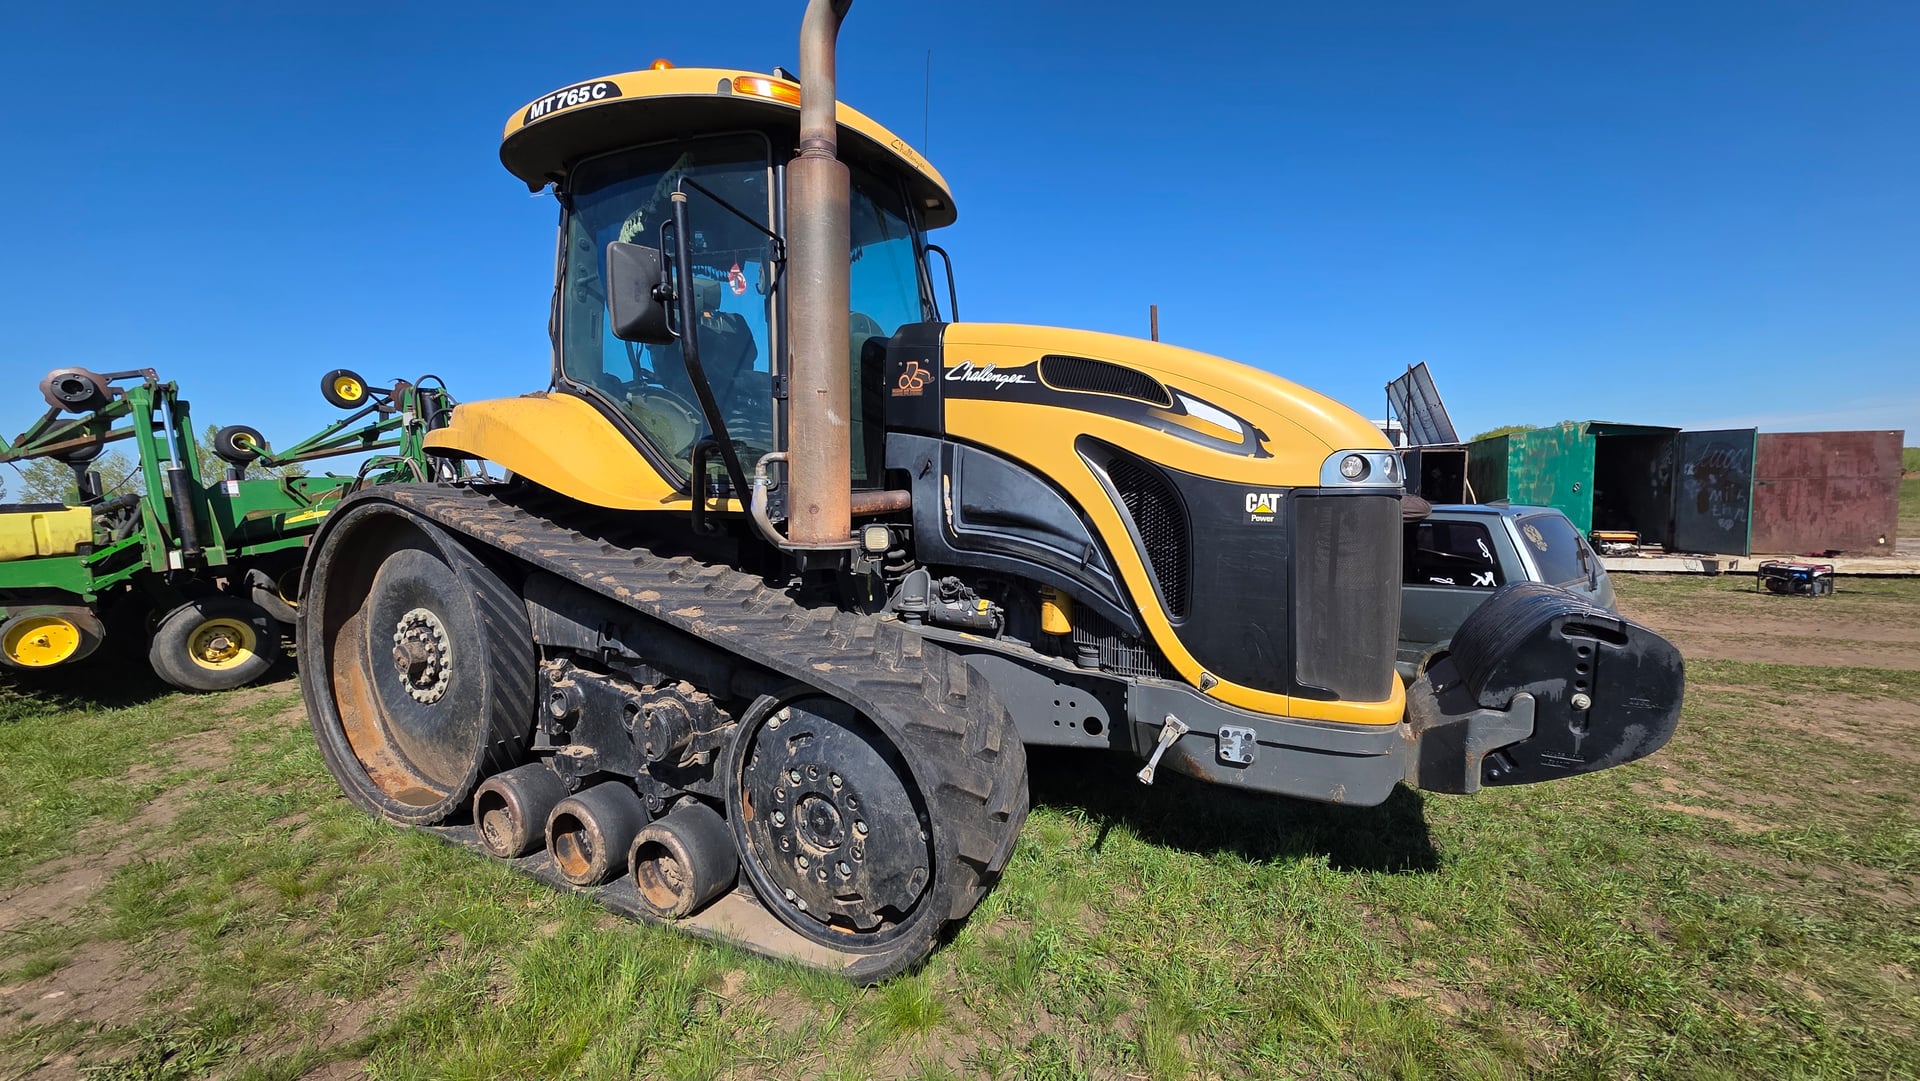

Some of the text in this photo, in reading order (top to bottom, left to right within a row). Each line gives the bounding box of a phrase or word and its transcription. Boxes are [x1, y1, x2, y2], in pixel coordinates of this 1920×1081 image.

[945, 360, 1036, 390] Challenger
[1245, 492, 1281, 513] CAT
[1250, 514, 1275, 523] Power
